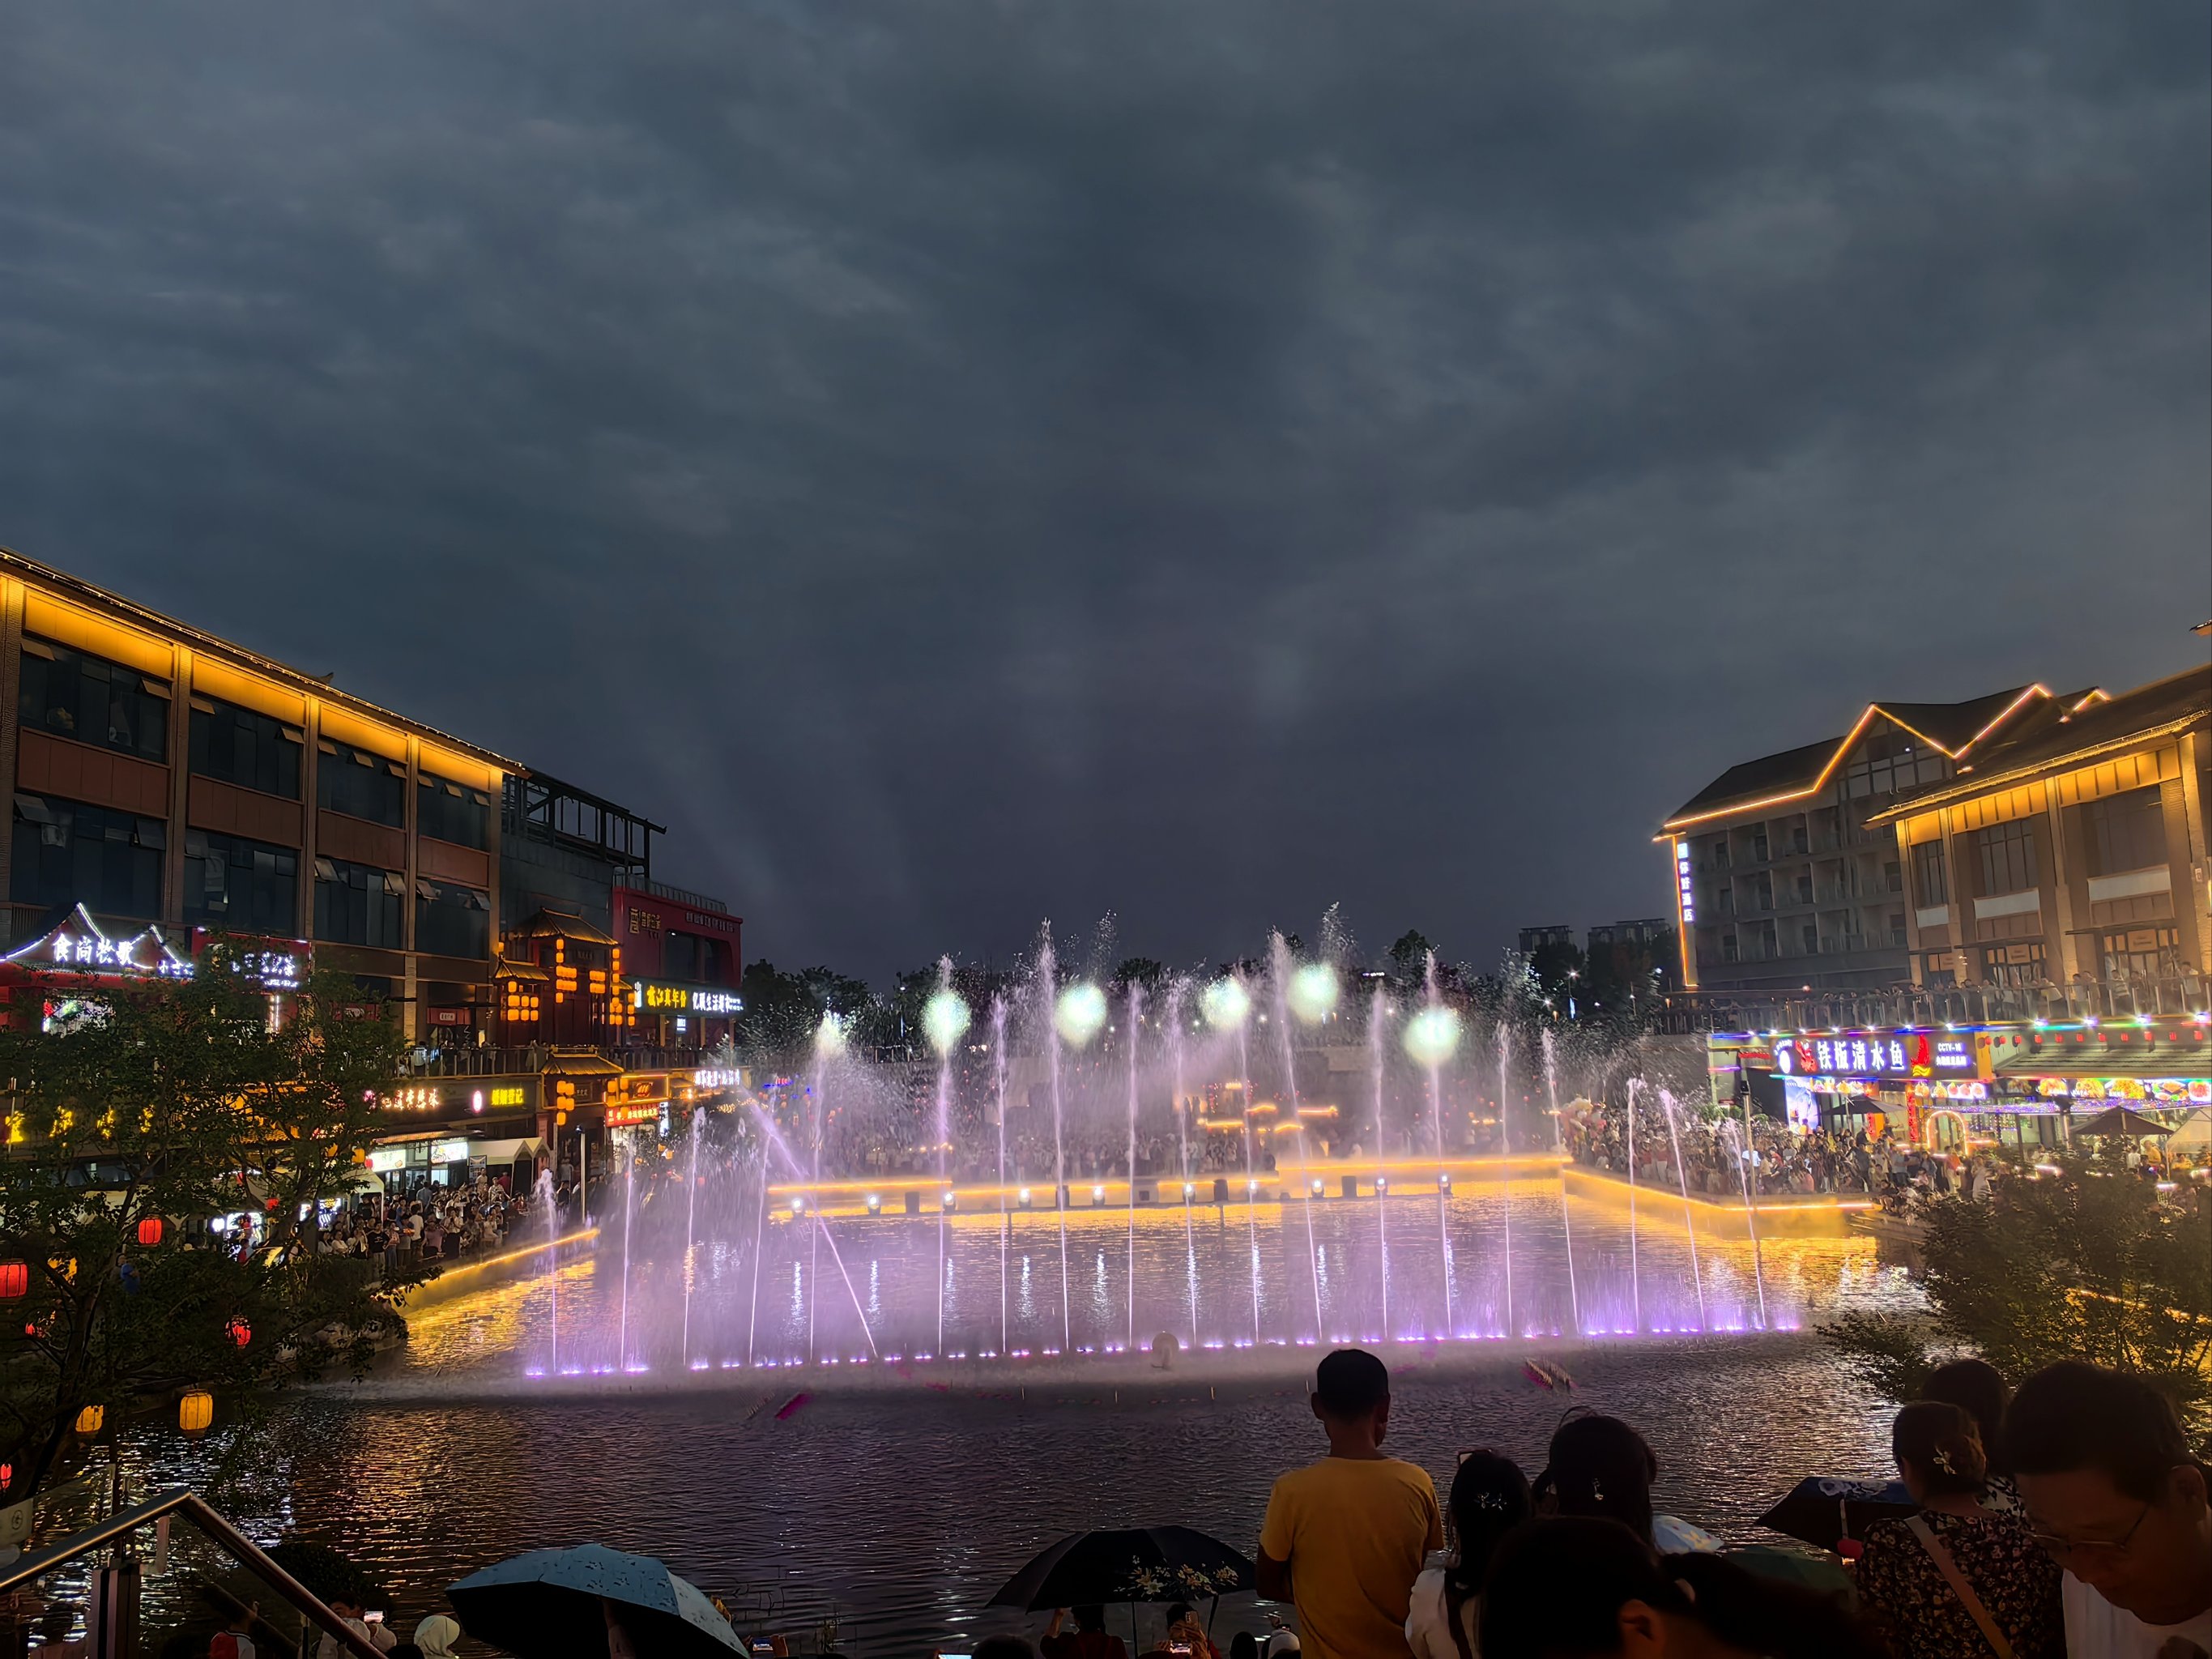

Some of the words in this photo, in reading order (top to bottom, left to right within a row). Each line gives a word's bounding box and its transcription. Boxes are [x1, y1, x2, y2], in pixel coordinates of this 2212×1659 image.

[1680, 861, 1693, 921] 你好酒店
[1817, 1040, 1905, 1070] 铁板清水鱼
